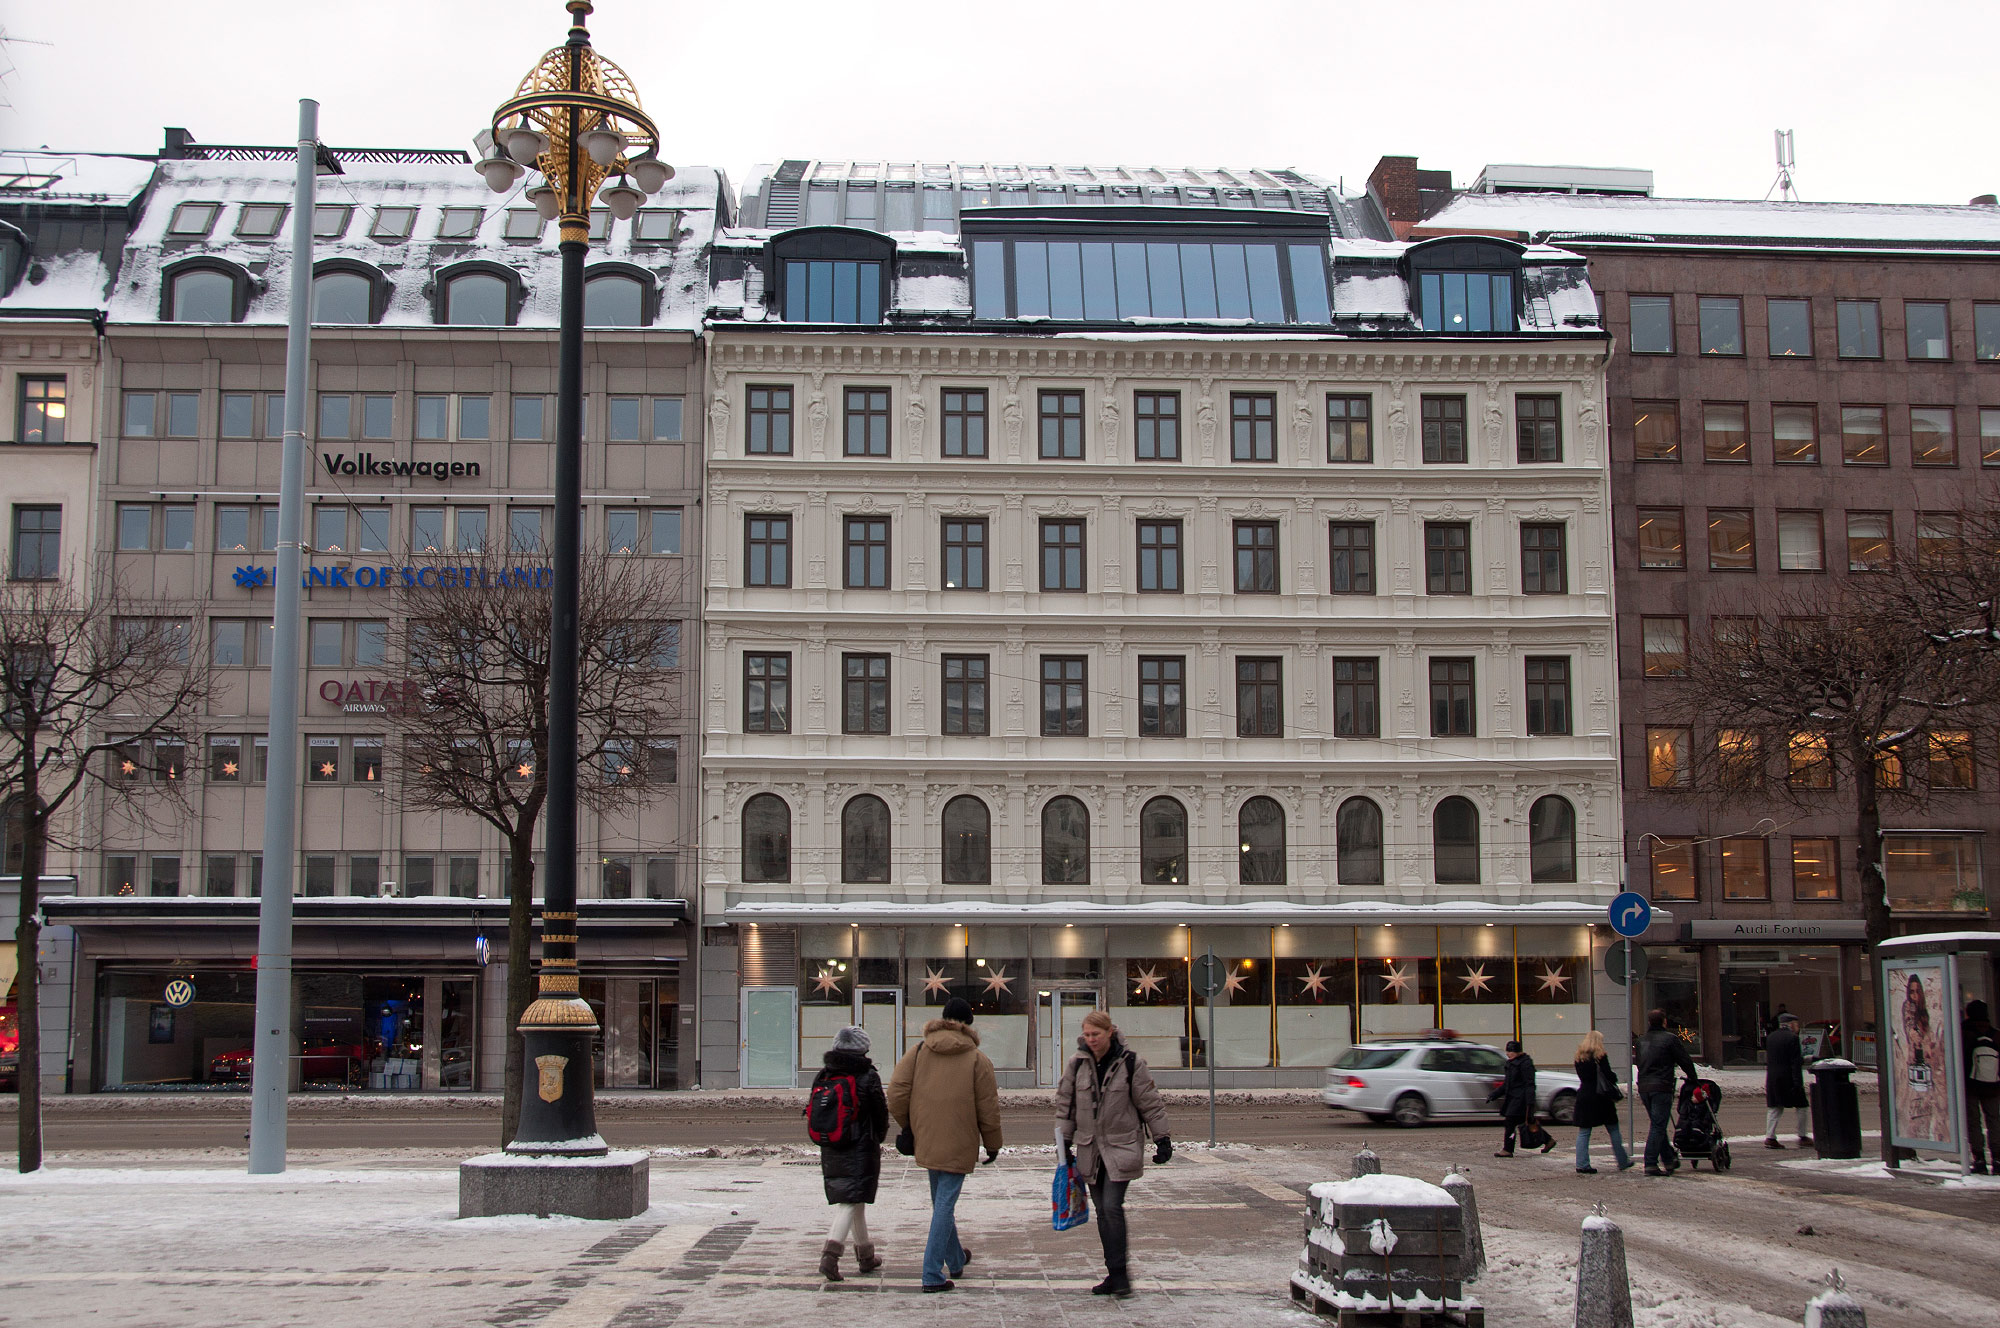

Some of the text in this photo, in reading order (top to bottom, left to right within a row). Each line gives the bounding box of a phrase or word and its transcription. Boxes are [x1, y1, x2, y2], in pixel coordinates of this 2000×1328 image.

[323, 453, 480, 481] Volkswagen
[272, 566, 553, 588] NK OF SCOTLAND
[319, 680, 419, 707] QATAR
[342, 703, 386, 713] AIRWAYS
[1734, 924, 1822, 934] Audi Forum
[165, 980, 192, 1005] VW
